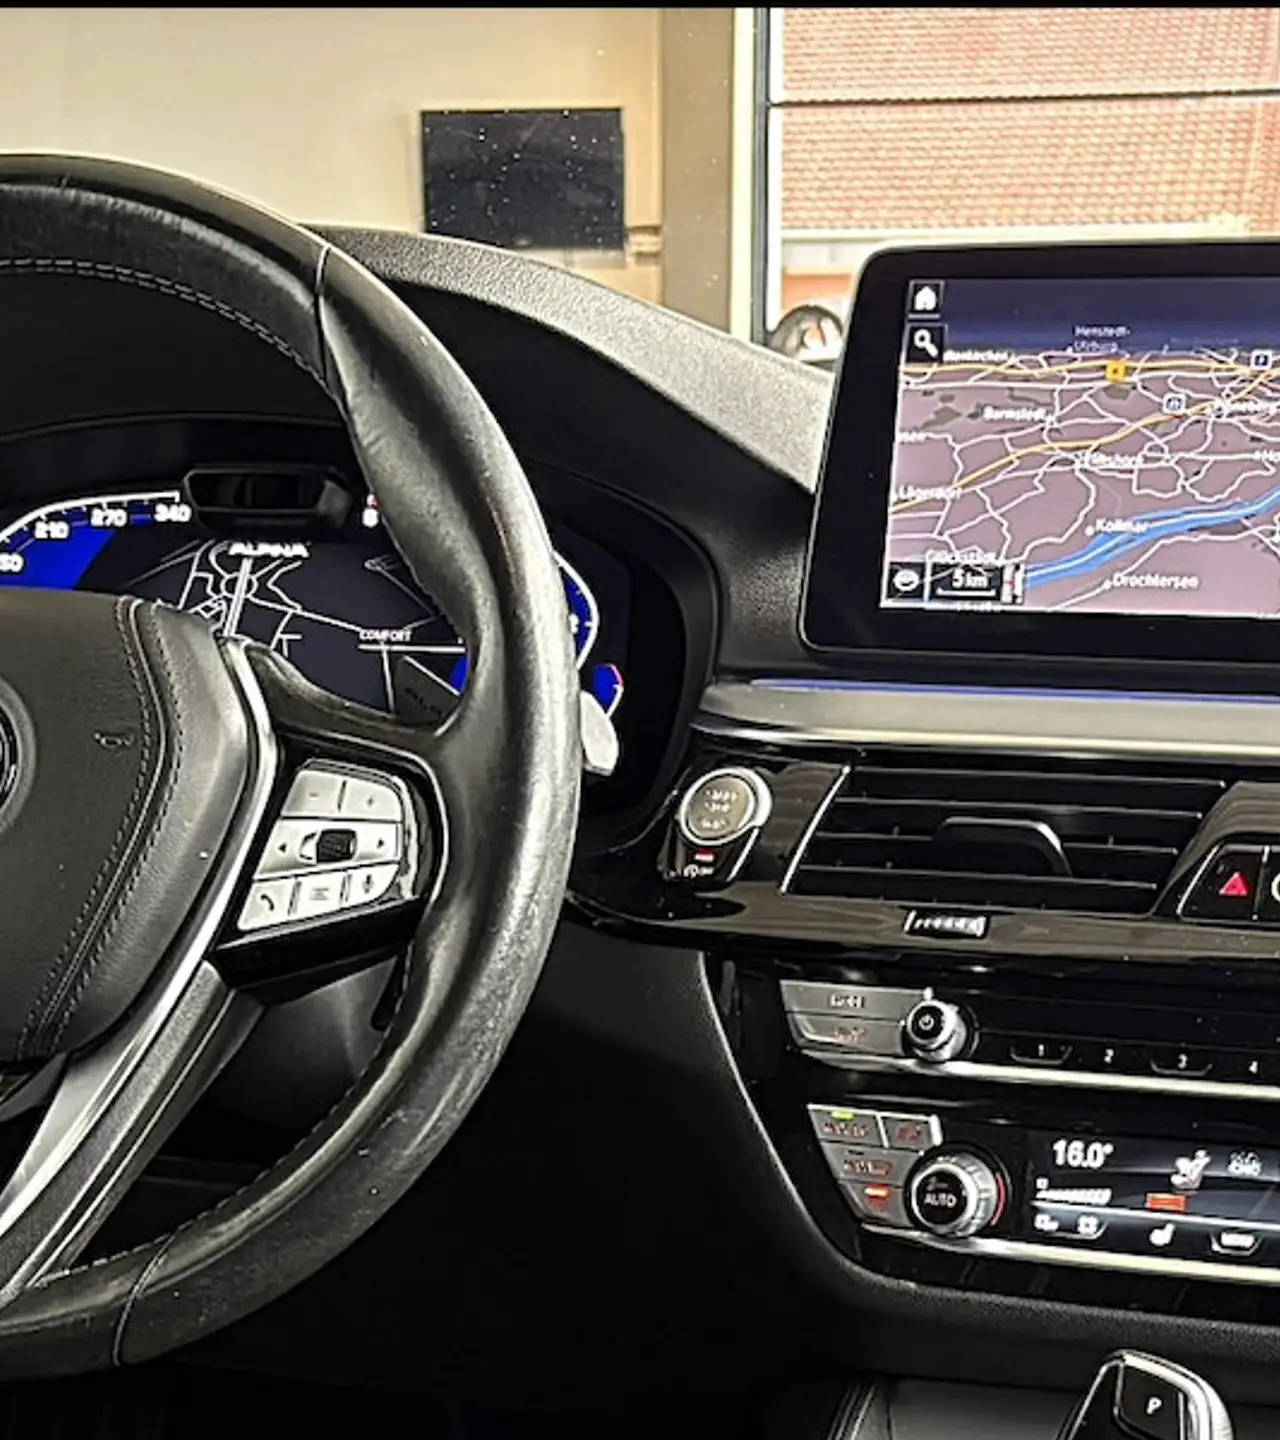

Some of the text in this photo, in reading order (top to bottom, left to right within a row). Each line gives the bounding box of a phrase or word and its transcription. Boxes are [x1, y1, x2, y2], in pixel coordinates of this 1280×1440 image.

[90, 508, 128, 528] 270
[153, 503, 192, 523] 340
[35, 520, 70, 539] 210
[1096, 518, 1150, 533] Kollmar
[229, 542, 310, 558] ALPINA
[951, 569, 989, 587] 5 km
[1113, 573, 1199, 590] Drochtersen
[358, 629, 413, 643] COMFORT
[1105, 1048, 1116, 1064] 2
[1178, 1053, 1190, 1070] 3
[1249, 1061, 1259, 1075] 4
[1053, 1138, 1114, 1169] 16.0°
[923, 1192, 958, 1209] AUTO
[1146, 1397, 1162, 1415] P
